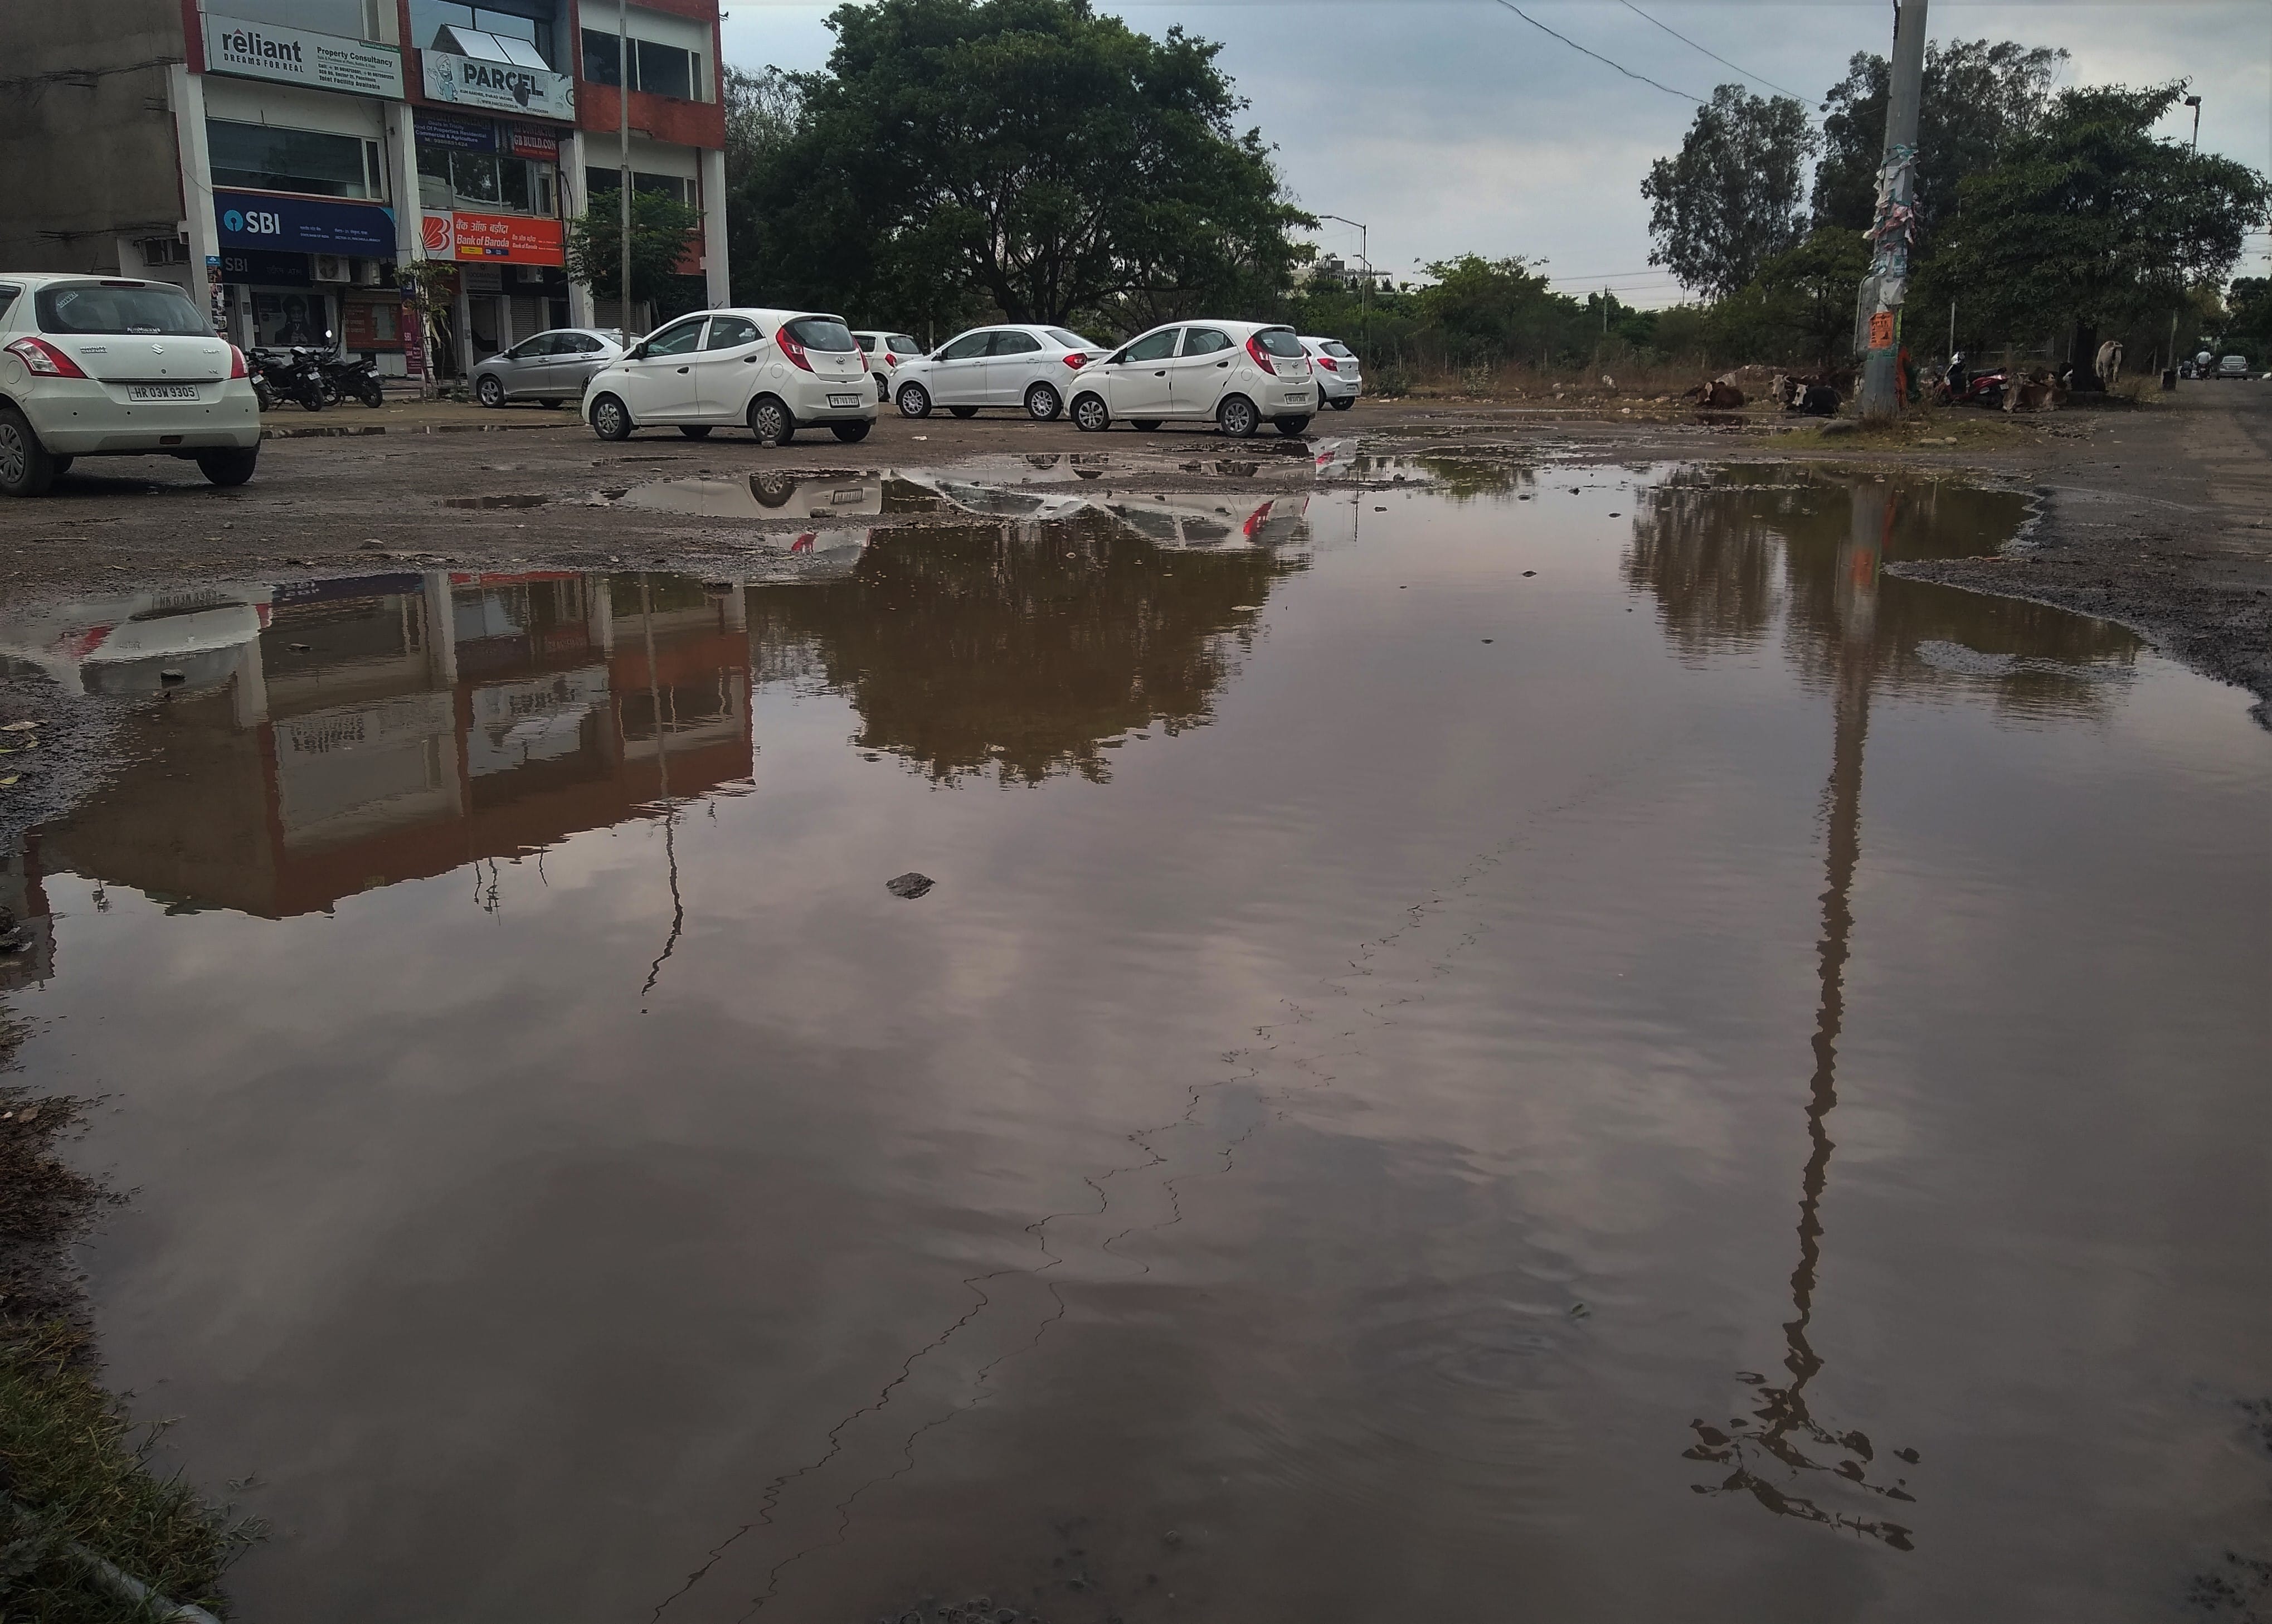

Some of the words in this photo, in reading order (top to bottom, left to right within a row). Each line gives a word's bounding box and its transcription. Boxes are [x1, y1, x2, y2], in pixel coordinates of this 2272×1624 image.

[224, 53, 261, 66] DREAMS
[264, 59, 280, 69] FOR
[283, 62, 304, 73] REAL
[317, 46, 348, 60] Property
[349, 52, 393, 67] Consultancy
[334, 77, 354, 86] Facility
[356, 81, 381, 90] Available
[464, 62, 544, 97] PARCEL
[415, 130, 445, 139] Commercial
[451, 135, 478, 143] Agriculture
[434, 127, 459, 135] Properties
[460, 129, 486, 138] Residential
[514, 134, 523, 146] GB
[246, 211, 280, 235] SBI
[456, 218, 469, 231] बैंक
[489, 221, 509, 235] बड़ौदा
[456, 234, 476, 245] Bank
[476, 236, 484, 245] of
[484, 236, 509, 247] Baroda
[225, 257, 249, 273] SBI
[134, 387, 148, 398] HR
[149, 387, 169, 398] 03W
[170, 386, 195, 397] 9305
